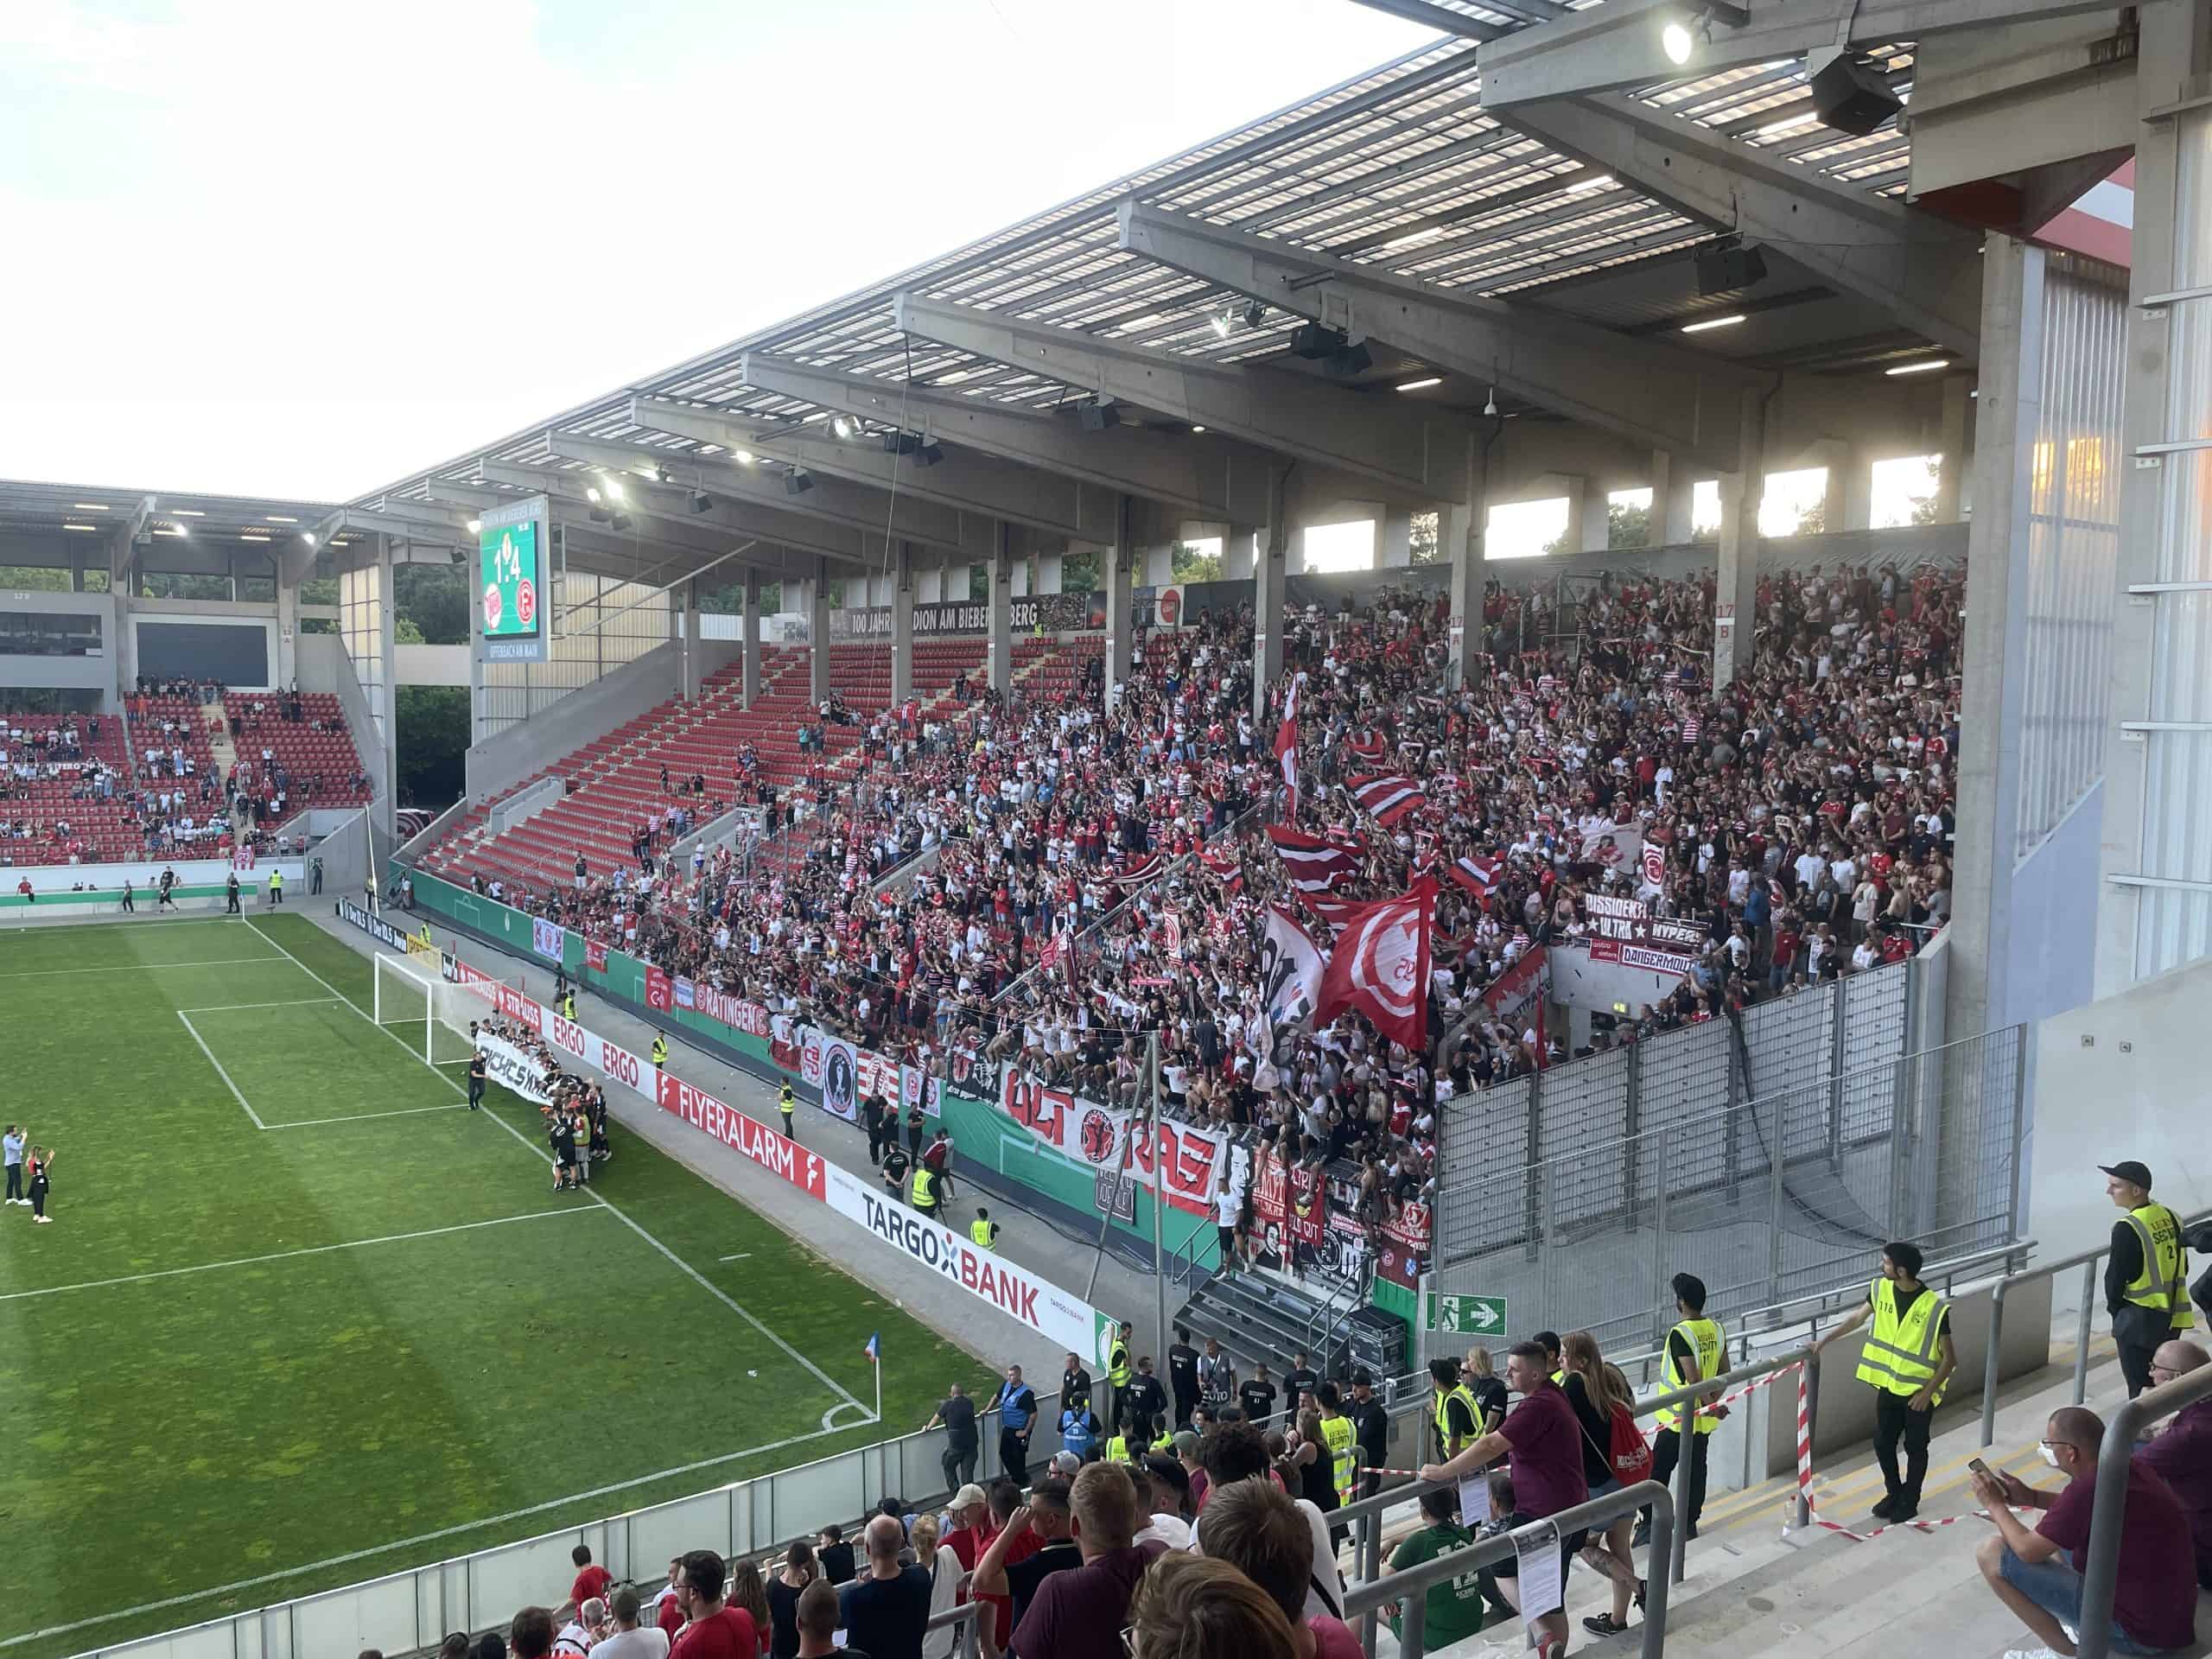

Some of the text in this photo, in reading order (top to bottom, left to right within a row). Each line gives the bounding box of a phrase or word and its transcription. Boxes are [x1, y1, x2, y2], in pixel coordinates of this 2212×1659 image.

[852, 614, 866, 633] 100
[868, 613, 893, 632] JAHR
[912, 609, 938, 631] DION
[939, 607, 956, 630] AM
[1010, 603, 1038, 626] BERG
[1599, 917, 1632, 940] ULTRA
[706, 987, 755, 1033] RATINGEN
[554, 1015, 586, 1058] ERGO
[602, 1042, 639, 1088] ERGO
[679, 1084, 795, 1182] FLYERALARM
